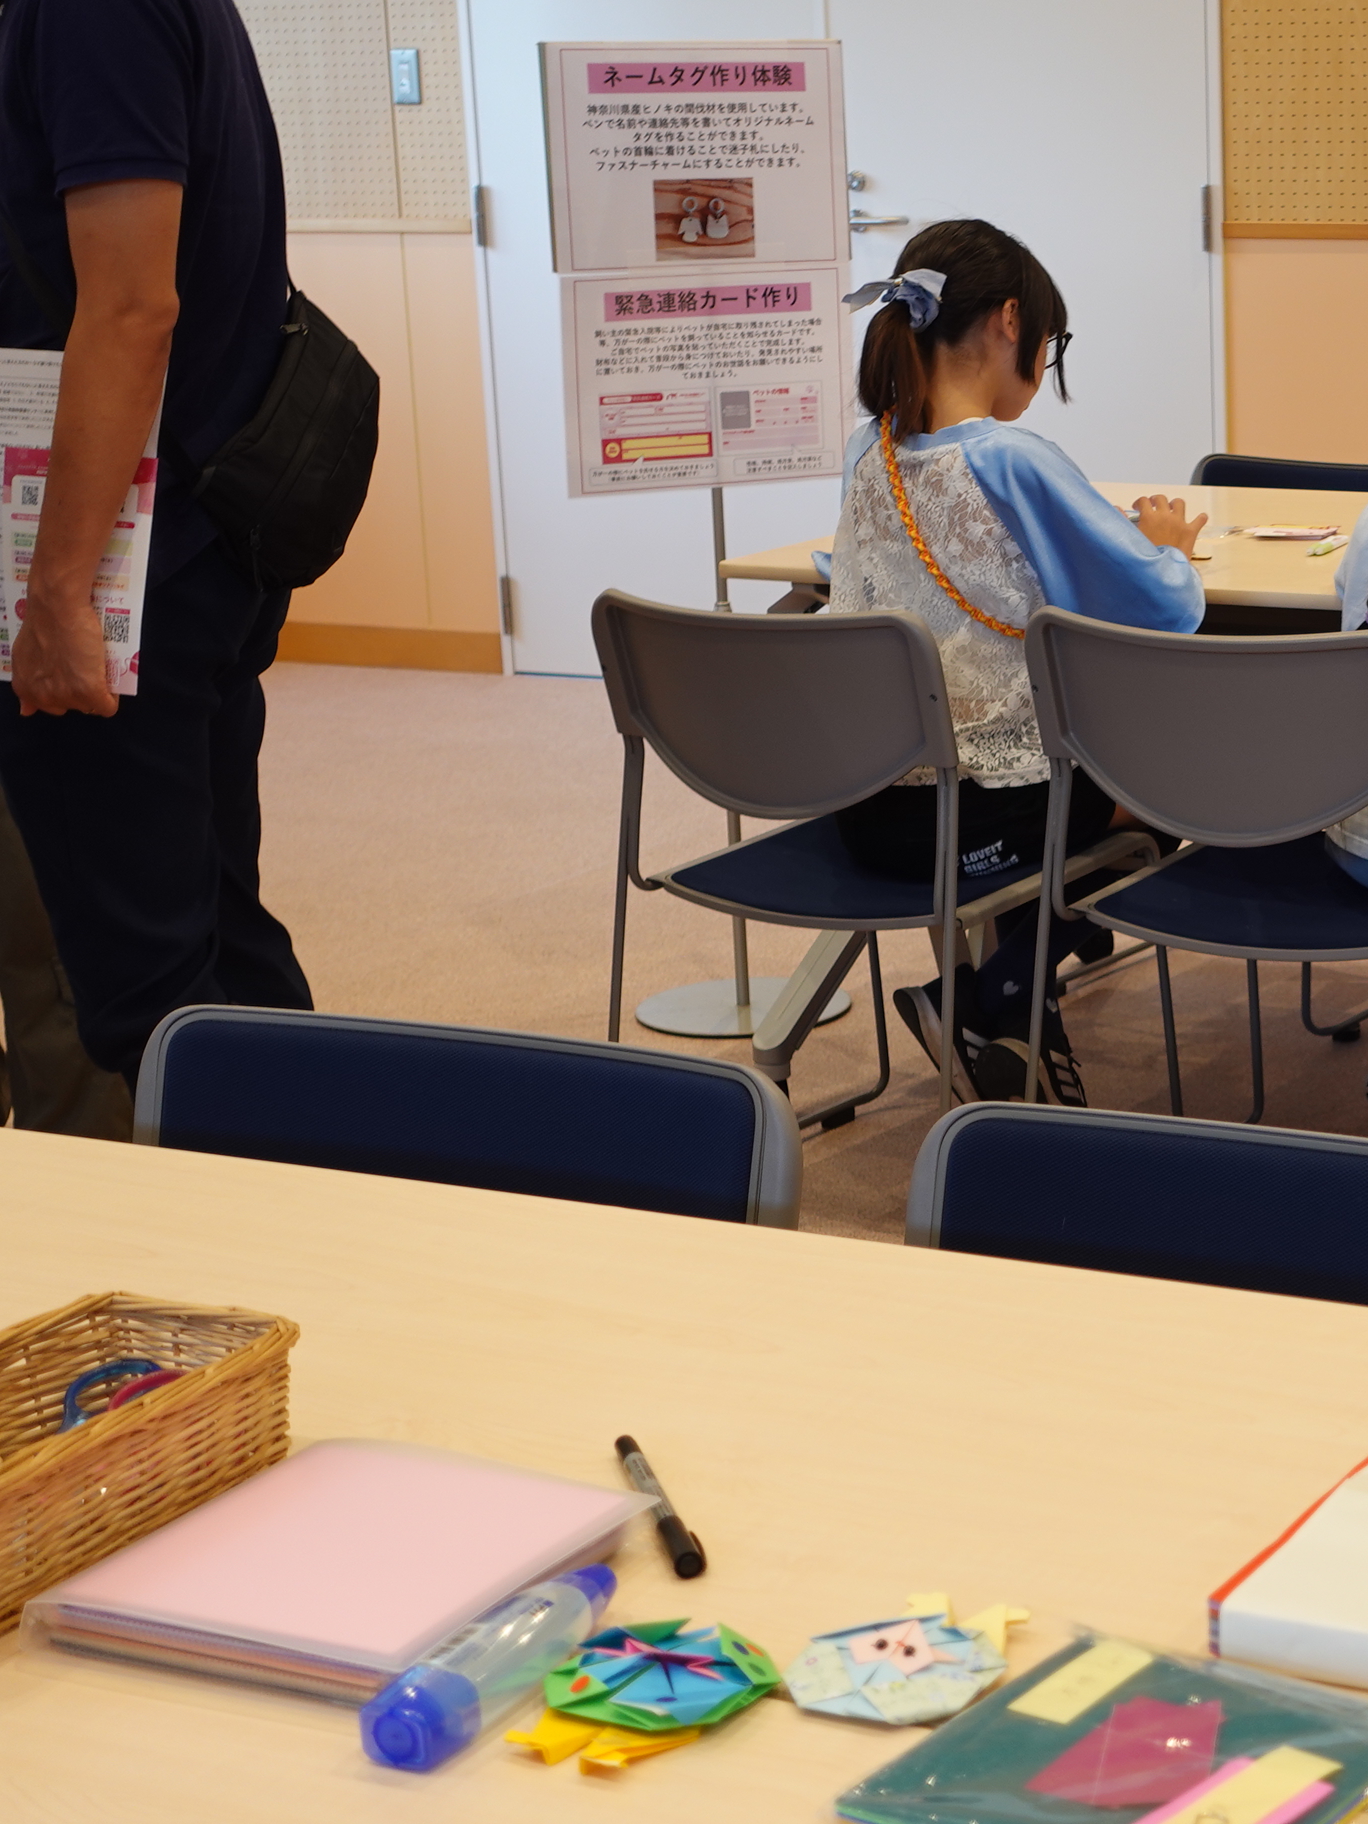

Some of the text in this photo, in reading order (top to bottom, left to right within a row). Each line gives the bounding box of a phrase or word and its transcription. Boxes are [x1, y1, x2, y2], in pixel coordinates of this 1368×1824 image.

[603, 65, 793, 88] ネームタグ作り体験
[586, 102, 805, 116] 神奈川県産ヒノキの間伐材を使用しています。
[582, 115, 815, 130] ペンで名前や連絡先等を書いてオリジナルネーム
[632, 130, 764, 143] タグを作ることができます。
[596, 158, 801, 172] ファスナーチャームにすることができます。
[614, 286, 799, 316] 緊急連絡カード作り
